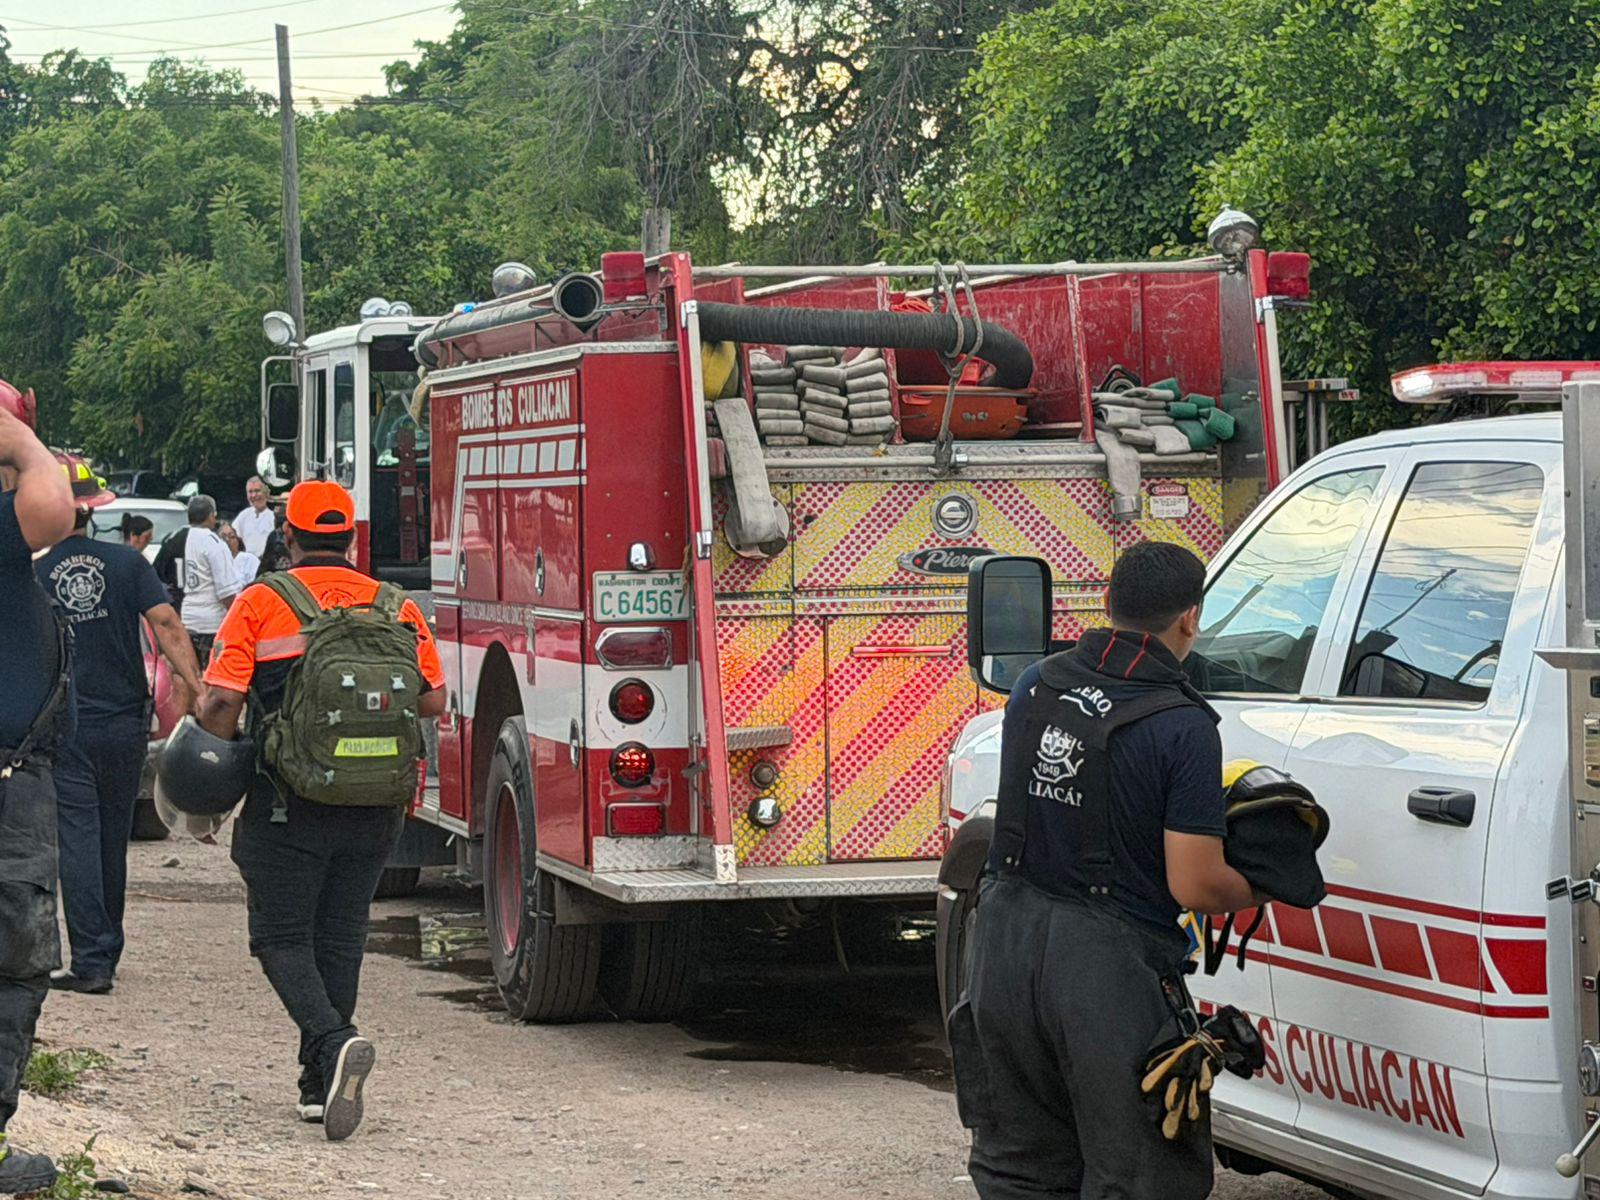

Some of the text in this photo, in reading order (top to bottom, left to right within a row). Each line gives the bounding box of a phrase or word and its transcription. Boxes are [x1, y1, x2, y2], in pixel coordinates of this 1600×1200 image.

[518, 378, 570, 424] CULIACAN
[923, 549, 977, 571] Pier
[1037, 761, 1060, 777] 1949
[1286, 1024, 1465, 1139] CULIACAN
